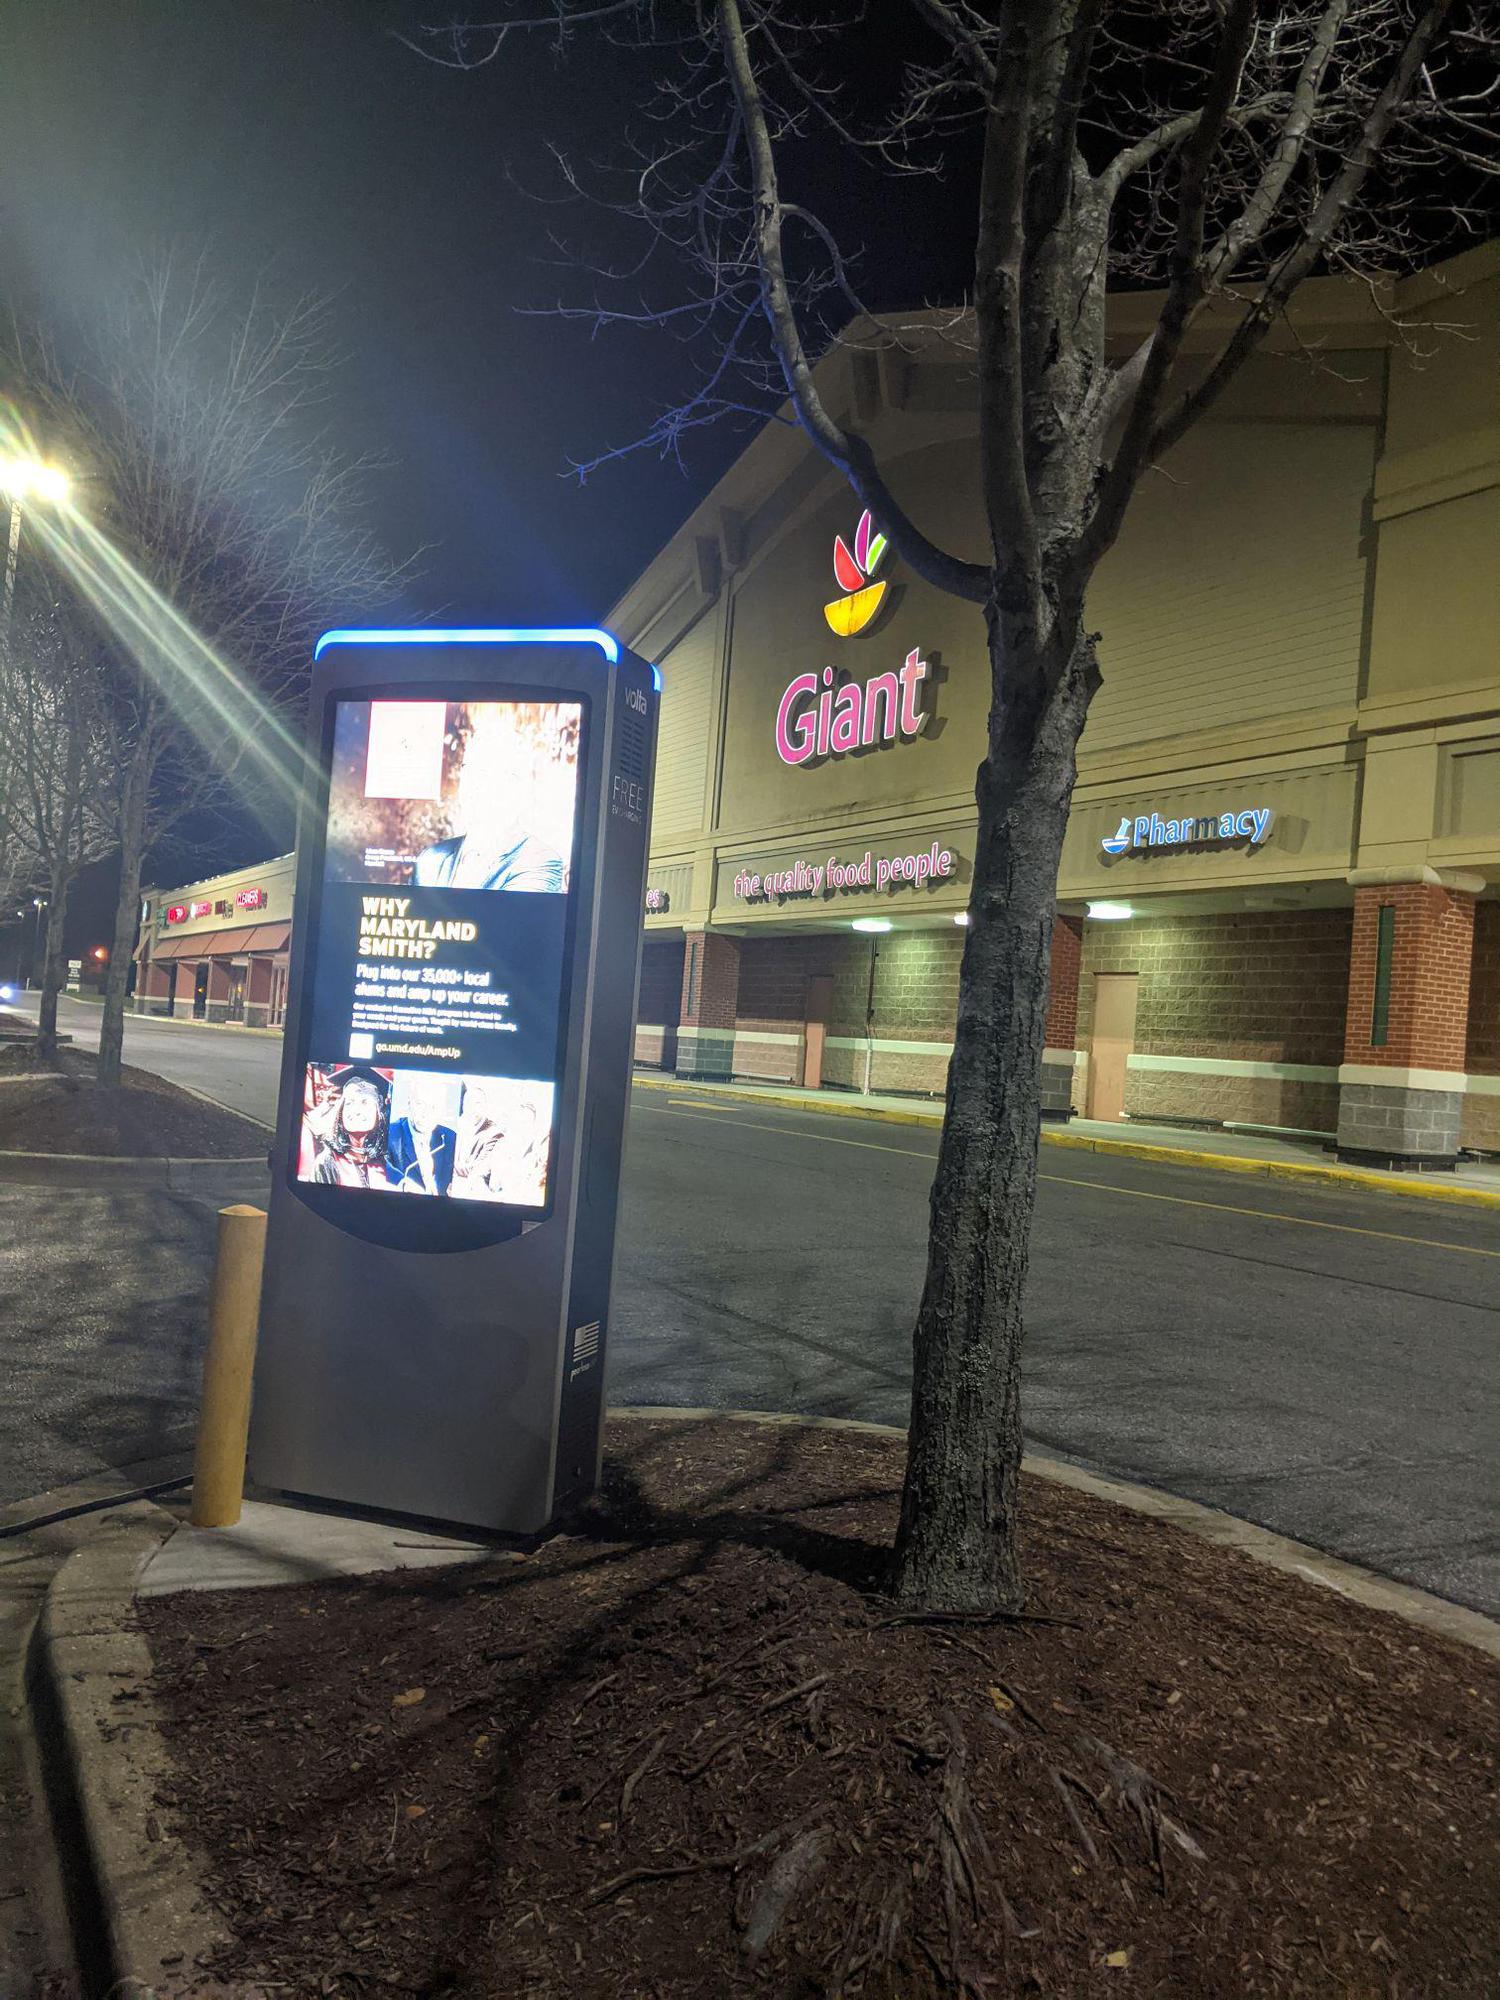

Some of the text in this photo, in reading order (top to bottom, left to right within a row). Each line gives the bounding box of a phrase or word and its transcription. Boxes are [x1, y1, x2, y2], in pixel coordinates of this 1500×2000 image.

[625, 686, 648, 716] volta
[775, 646, 928, 765] Giant
[612, 775, 644, 813] FREE
[1133, 808, 1270, 847] Pharmacy
[734, 841, 952, 901] the quality food people
[362, 896, 411, 917] WHY
[360, 917, 477, 942] MARYLAND
[358, 937, 437, 960] SMITH?
[355, 963, 380, 982] Plug
[380, 964, 401, 981] into
[463, 970, 490, 987] local
[431, 989, 447, 1005] up
[447, 990, 472, 1005] your
